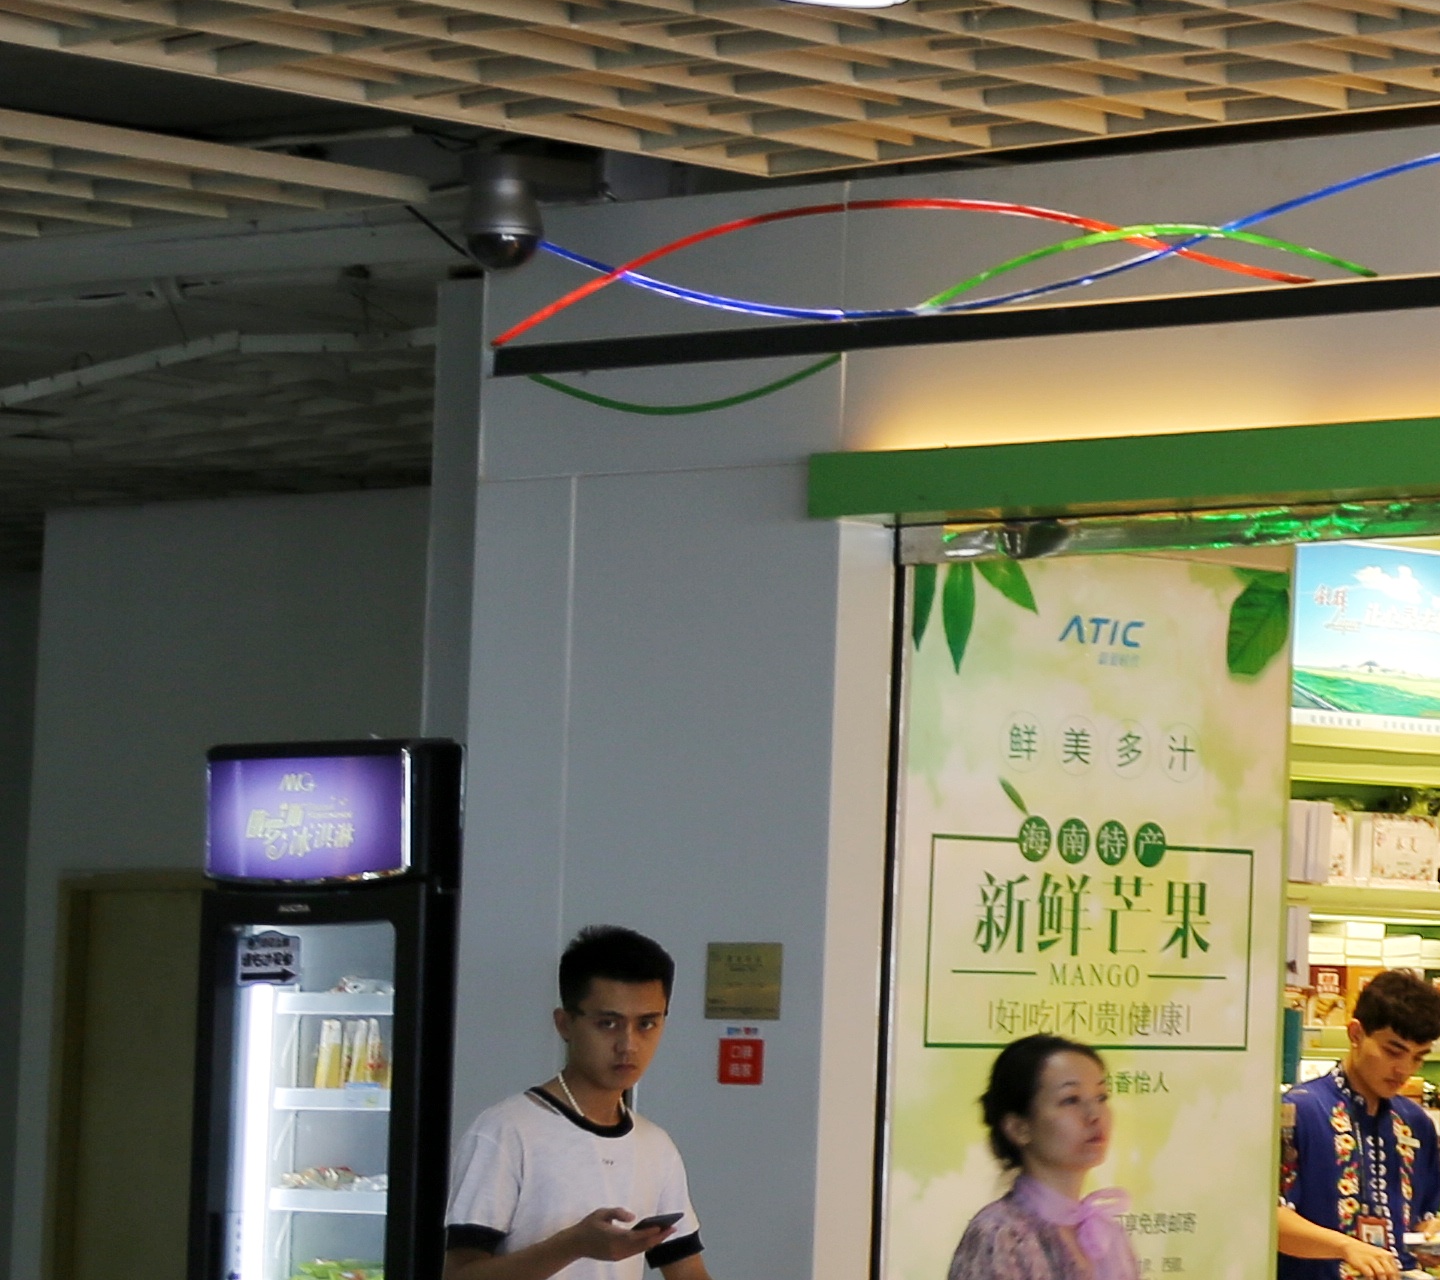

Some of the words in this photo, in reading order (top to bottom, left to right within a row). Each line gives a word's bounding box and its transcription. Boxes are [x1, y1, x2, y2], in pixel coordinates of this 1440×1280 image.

[1058, 614, 1145, 648] ATIC
[1008, 723, 1196, 772] 鲜美多汁
[1022, 823, 1164, 859] 海南特产
[974, 871, 1212, 959] 新鲜芒果
[1049, 963, 1141, 989] MANGO
